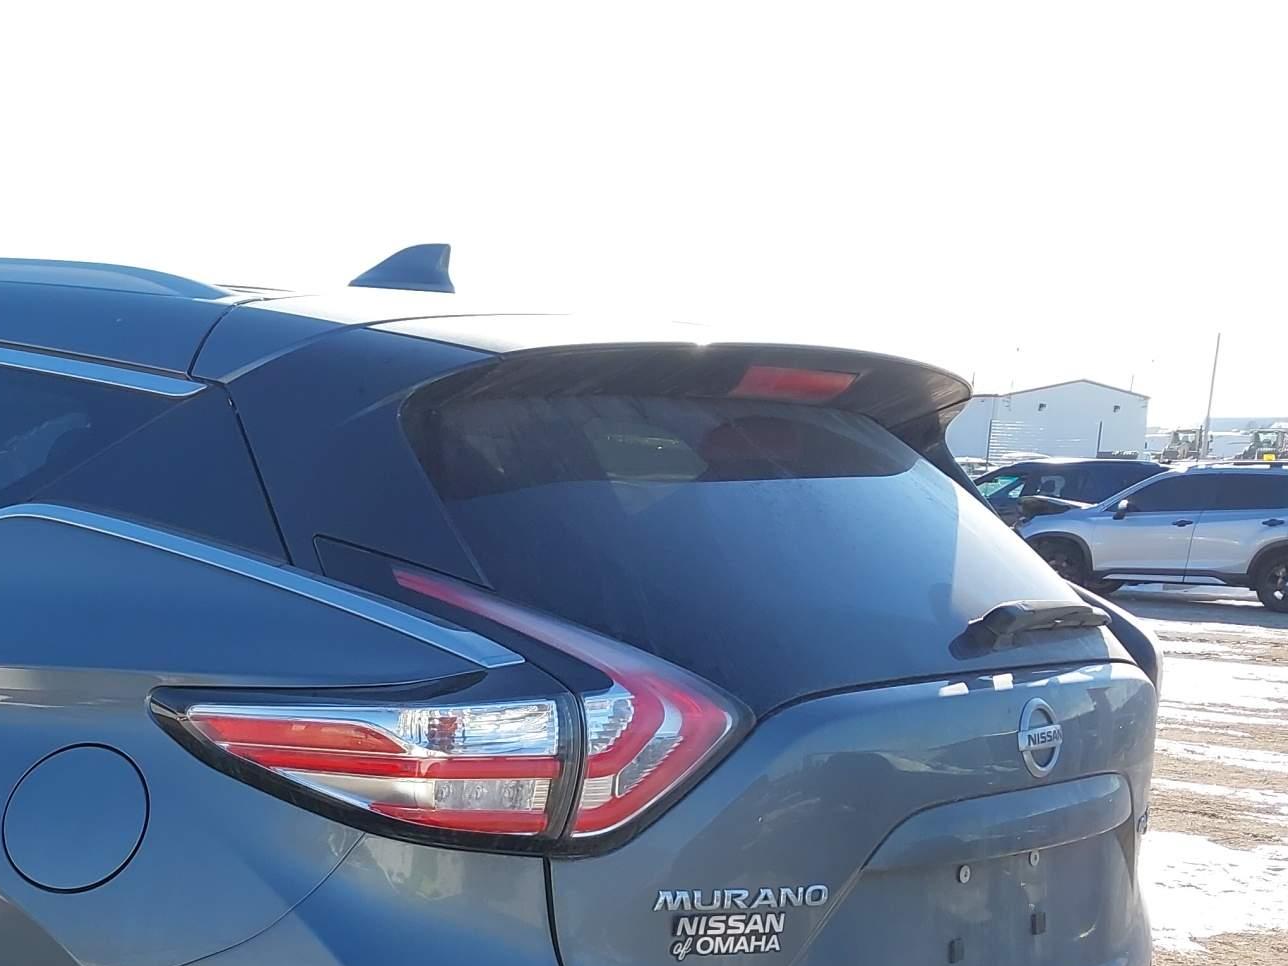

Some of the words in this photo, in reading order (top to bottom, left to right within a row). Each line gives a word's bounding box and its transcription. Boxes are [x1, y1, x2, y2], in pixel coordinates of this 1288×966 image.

[1027, 730, 1062, 746] NISSAN
[654, 884, 829, 911] MURANO
[676, 912, 786, 937] NISSAN
[673, 937, 693, 961] of
[696, 934, 781, 954] OMAHA
